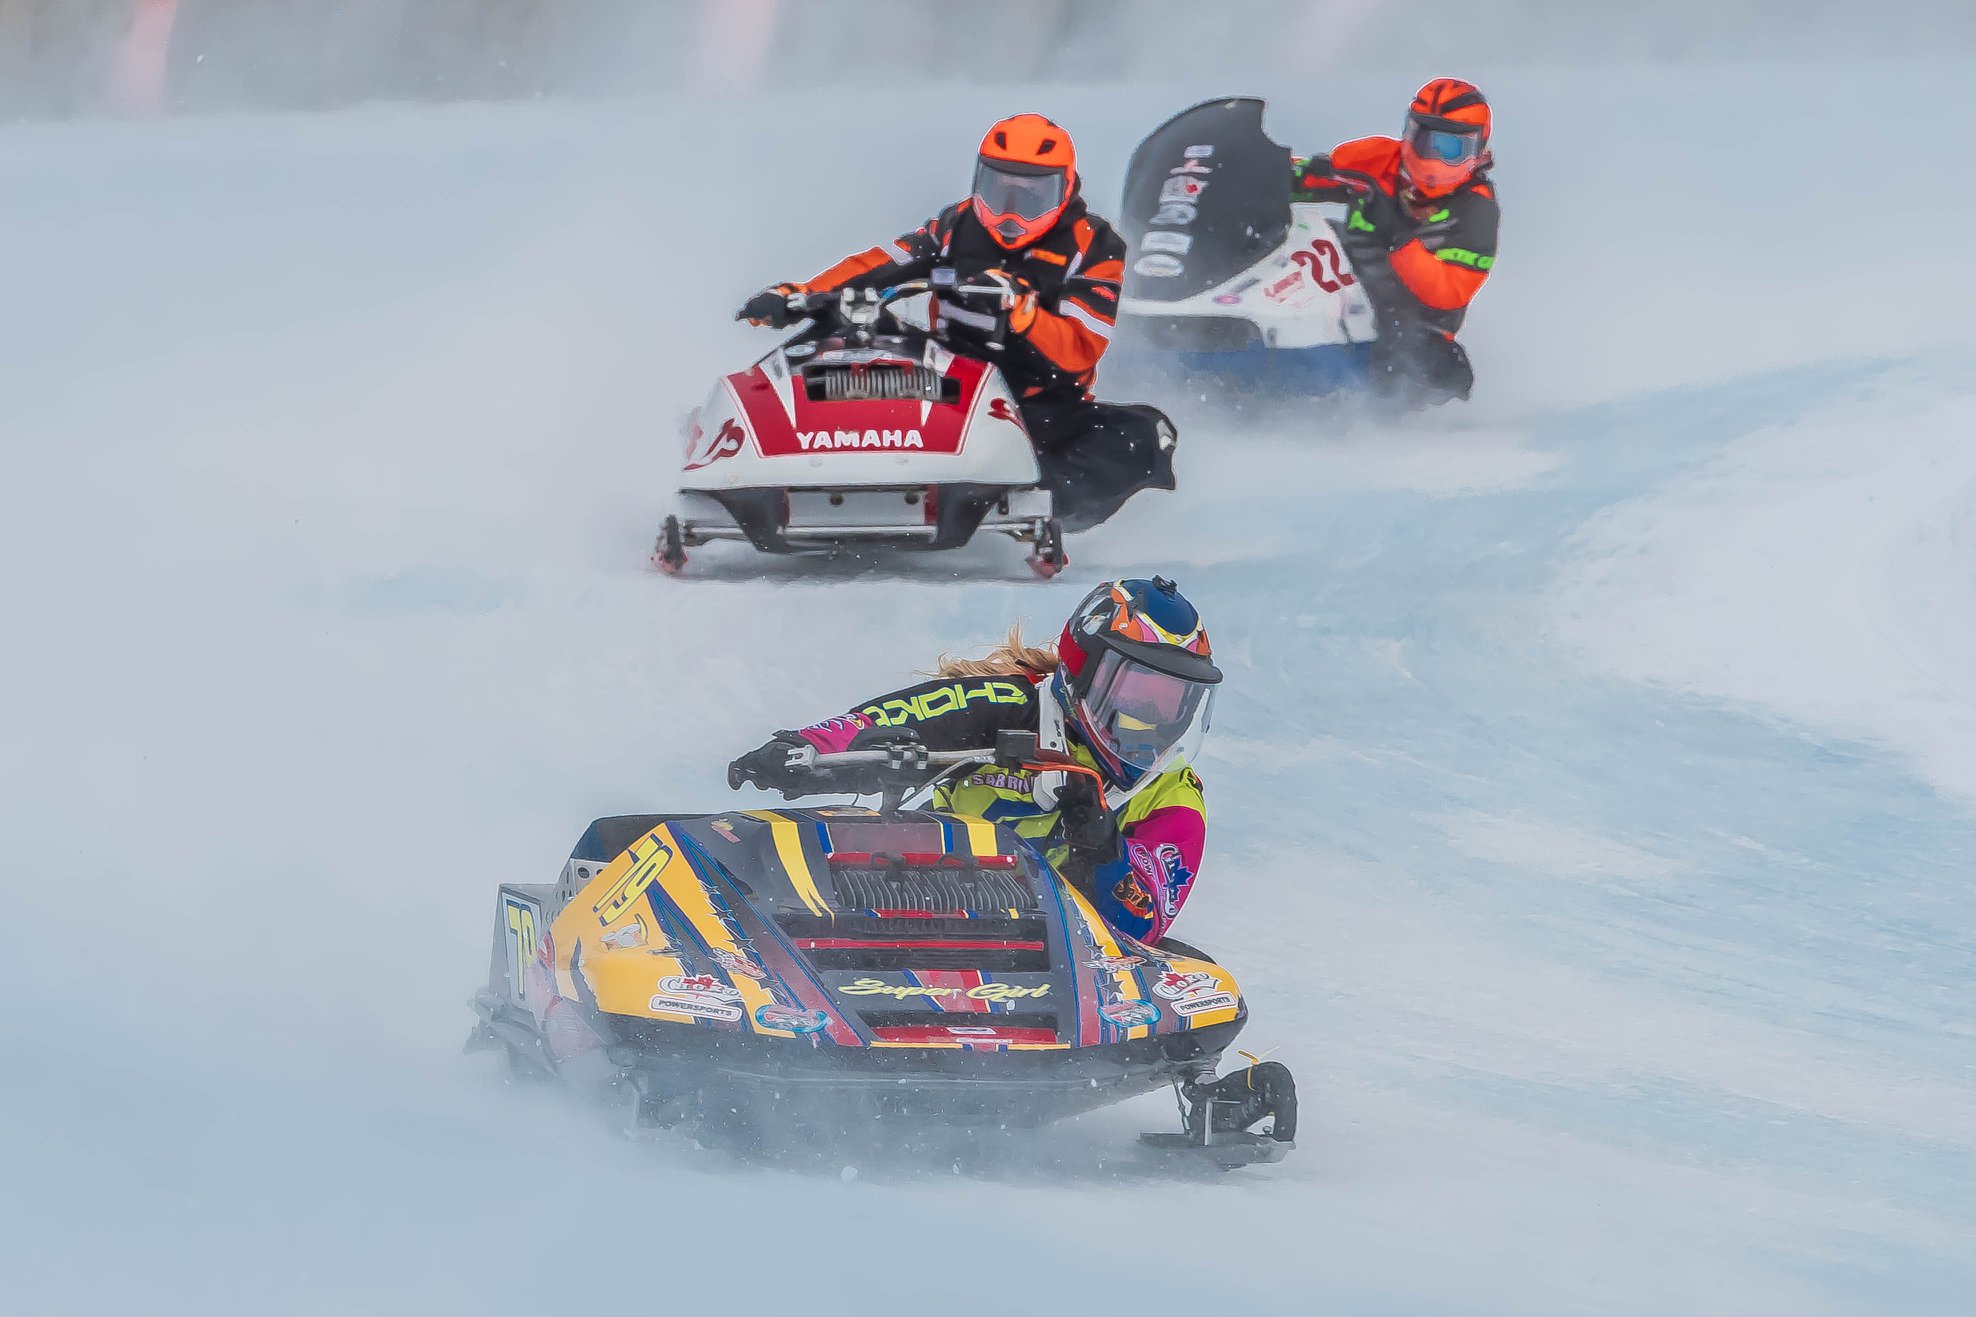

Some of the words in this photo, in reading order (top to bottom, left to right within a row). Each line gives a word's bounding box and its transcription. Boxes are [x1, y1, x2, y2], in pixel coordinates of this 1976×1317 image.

[1290, 238, 1355, 293] 22
[796, 429, 924, 450] YAMAHA
[592, 833, 673, 927] 19
[838, 979, 962, 1000] Super
[965, 982, 1051, 1003] Girl
[658, 998, 733, 1018] POWERSPORTS
[1179, 995, 1232, 1012] POWERSPORTS
